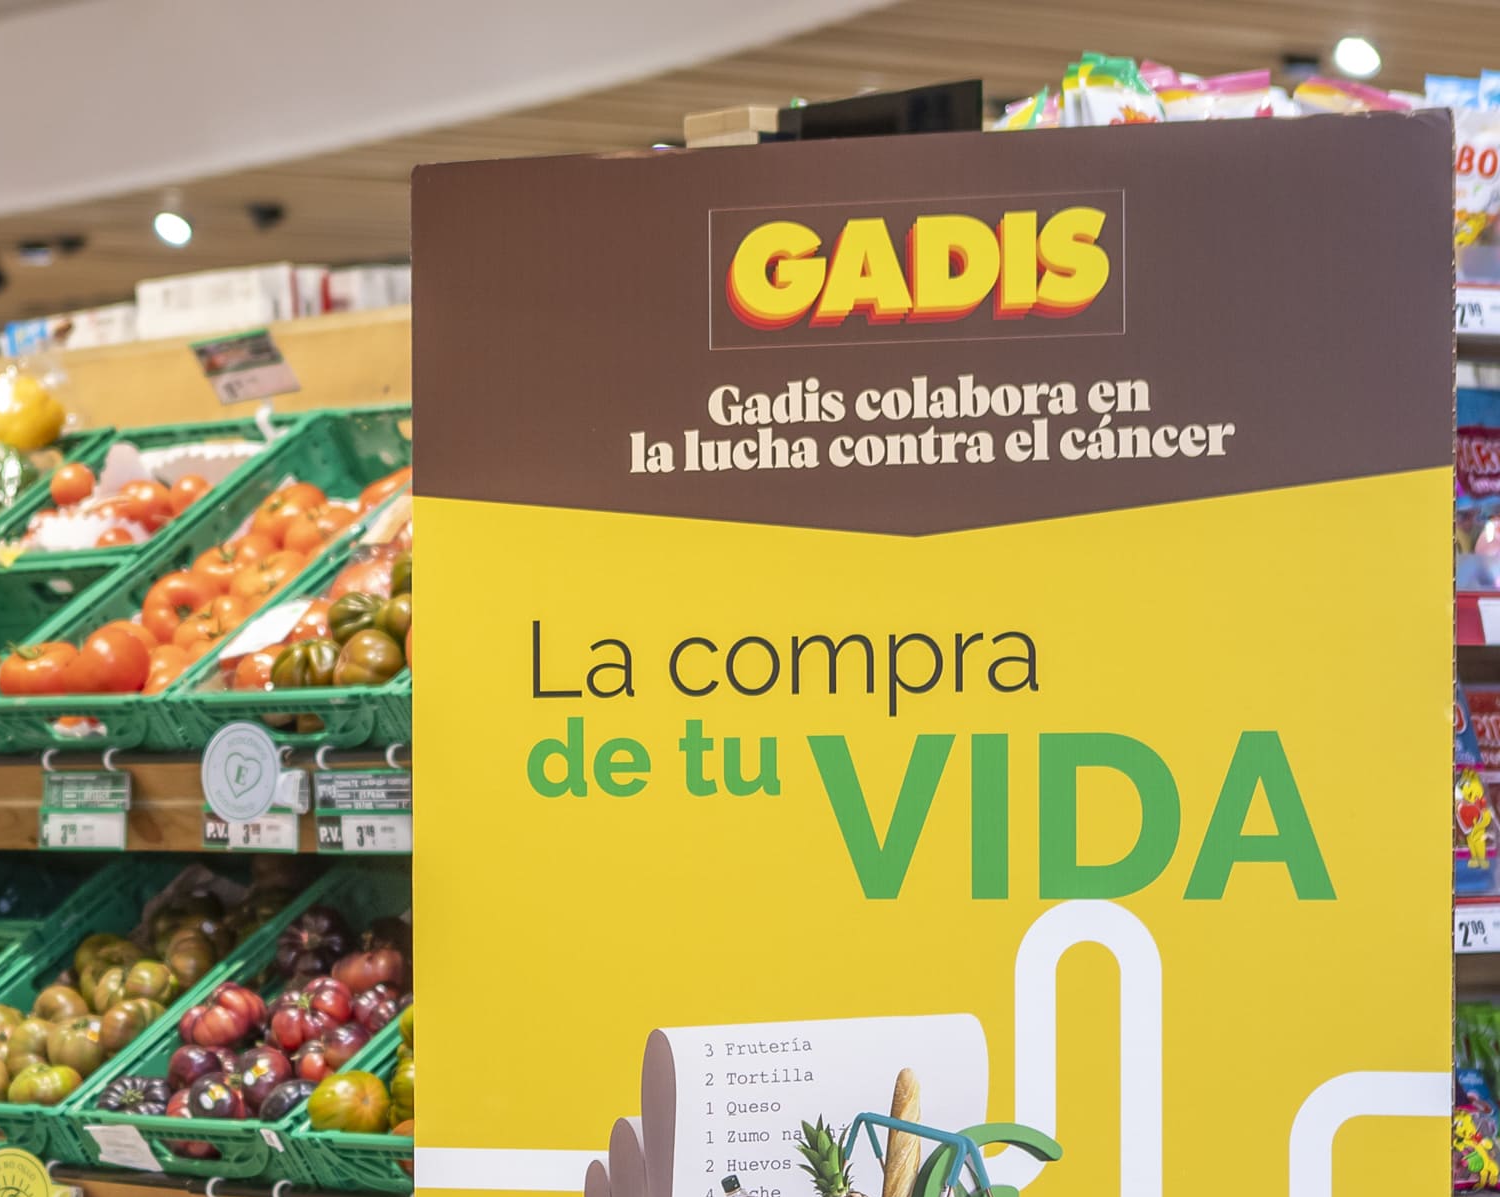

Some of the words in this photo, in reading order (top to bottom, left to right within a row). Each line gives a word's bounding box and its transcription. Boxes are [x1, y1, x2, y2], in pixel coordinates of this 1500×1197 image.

[726, 206, 1112, 332] GADIS
[707, 377, 846, 426] Gadis
[855, 374, 1079, 421] colabora
[1087, 379, 1151, 414] en
[629, 431, 676, 474] la
[683, 427, 820, 472] lucha
[828, 425, 996, 468] contra
[1004, 417, 1050, 462] el
[1059, 413, 1236, 461] cáncer
[532, 620, 635, 699] La
[668, 631, 1039, 718] compra
[526, 716, 652, 798] de
[678, 719, 781, 797] tu
[806, 730, 1338, 901] VIDA
[703, 1043, 715, 1058] 3
[724, 1037, 813, 1057] Frutería
[704, 1072, 715, 1087] 2
[725, 1068, 815, 1086] Tortilla
[705, 1101, 715, 1115] 1
[726, 1101, 782, 1117] Queso
[705, 1130, 715, 1144] 1
[726, 1130, 771, 1143] Zumo
[705, 1159, 715, 1173] 2
[726, 1158, 793, 1173] Huevos
